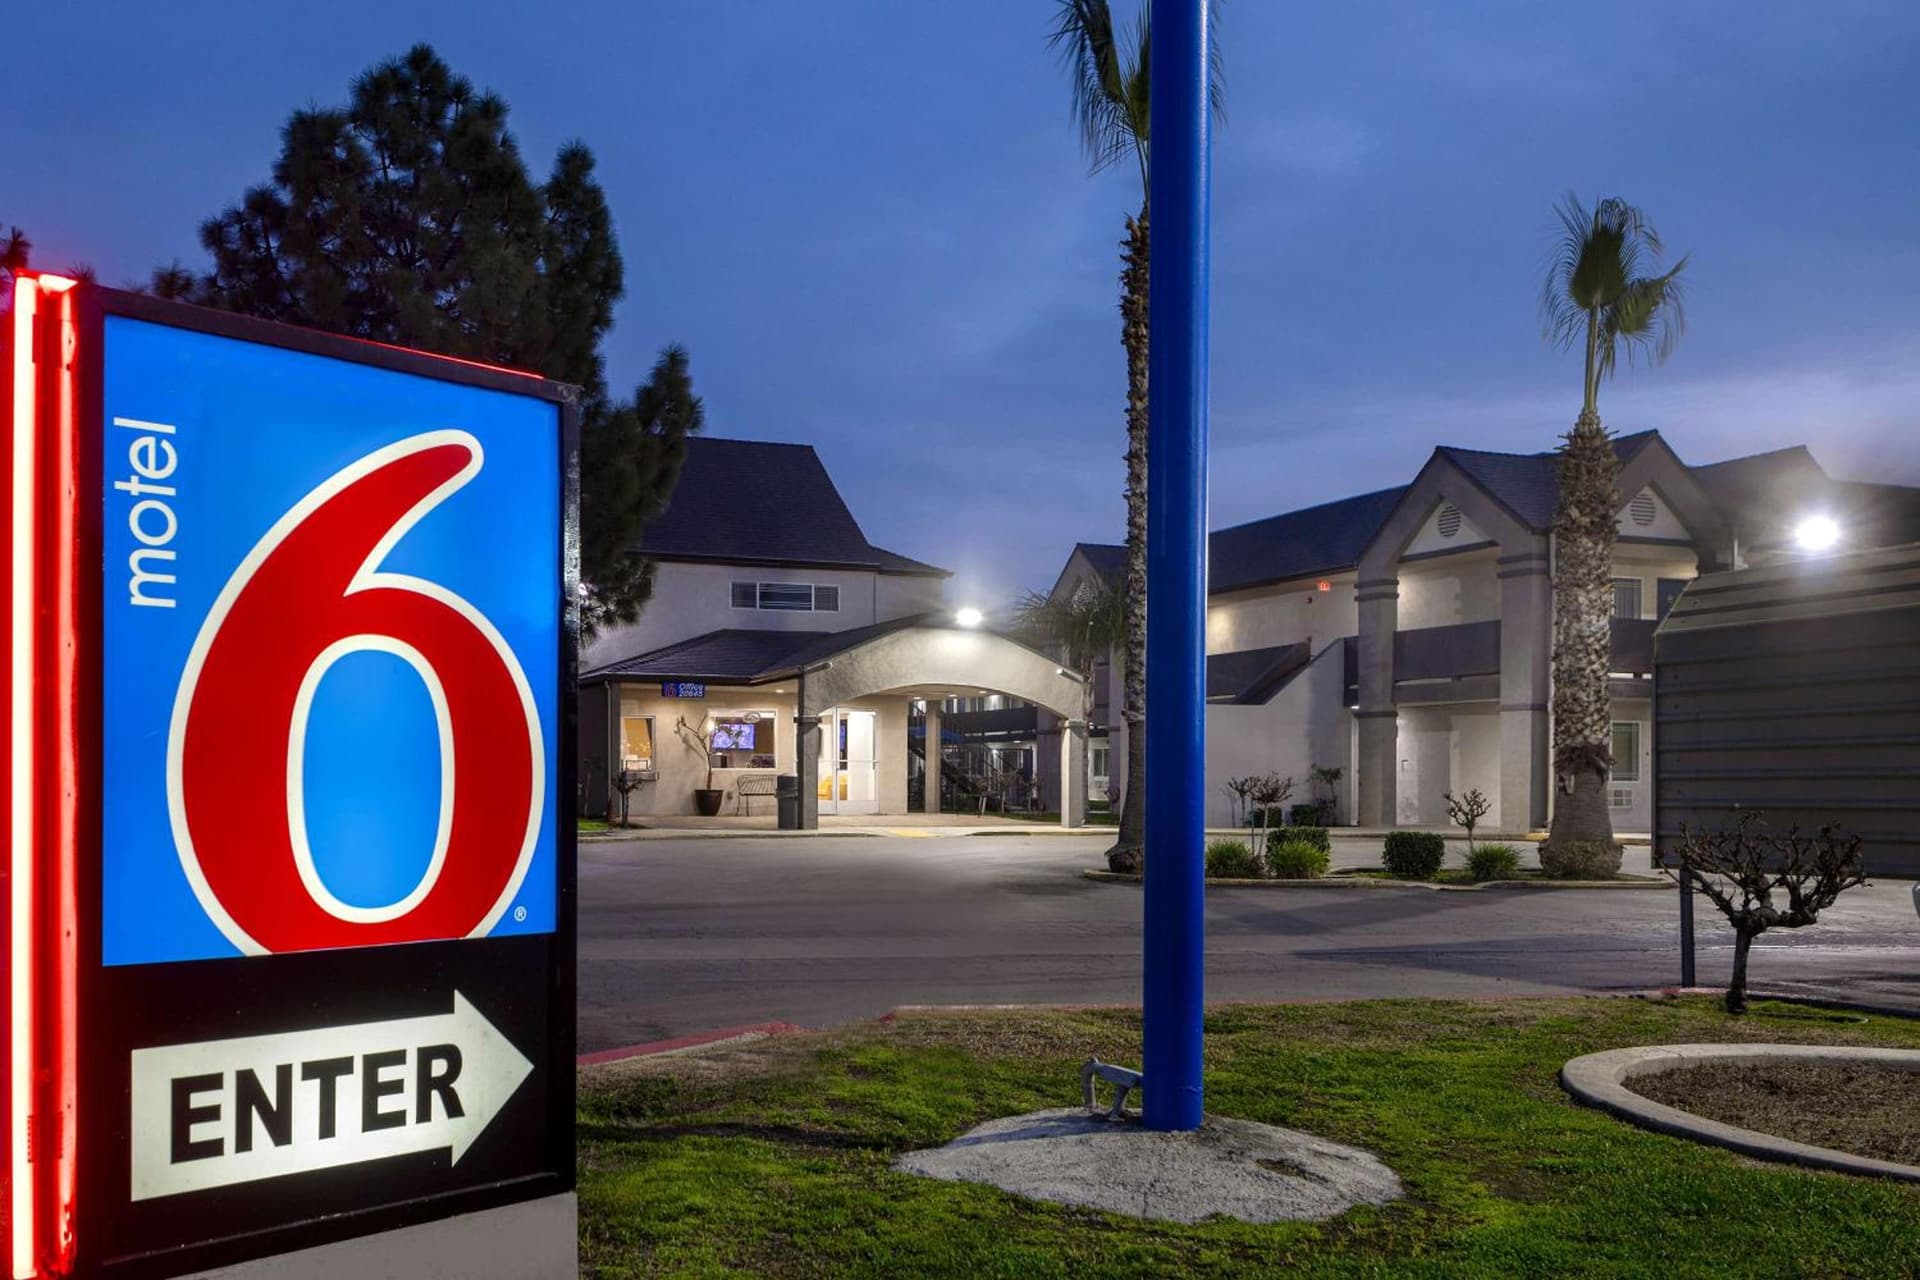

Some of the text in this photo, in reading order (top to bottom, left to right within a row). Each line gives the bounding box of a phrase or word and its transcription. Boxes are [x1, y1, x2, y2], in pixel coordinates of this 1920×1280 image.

[114, 417, 177, 608] motel
[166, 428, 546, 957] 6
[679, 682, 704, 691] Office
[170, 1043, 466, 1165] ENTER
